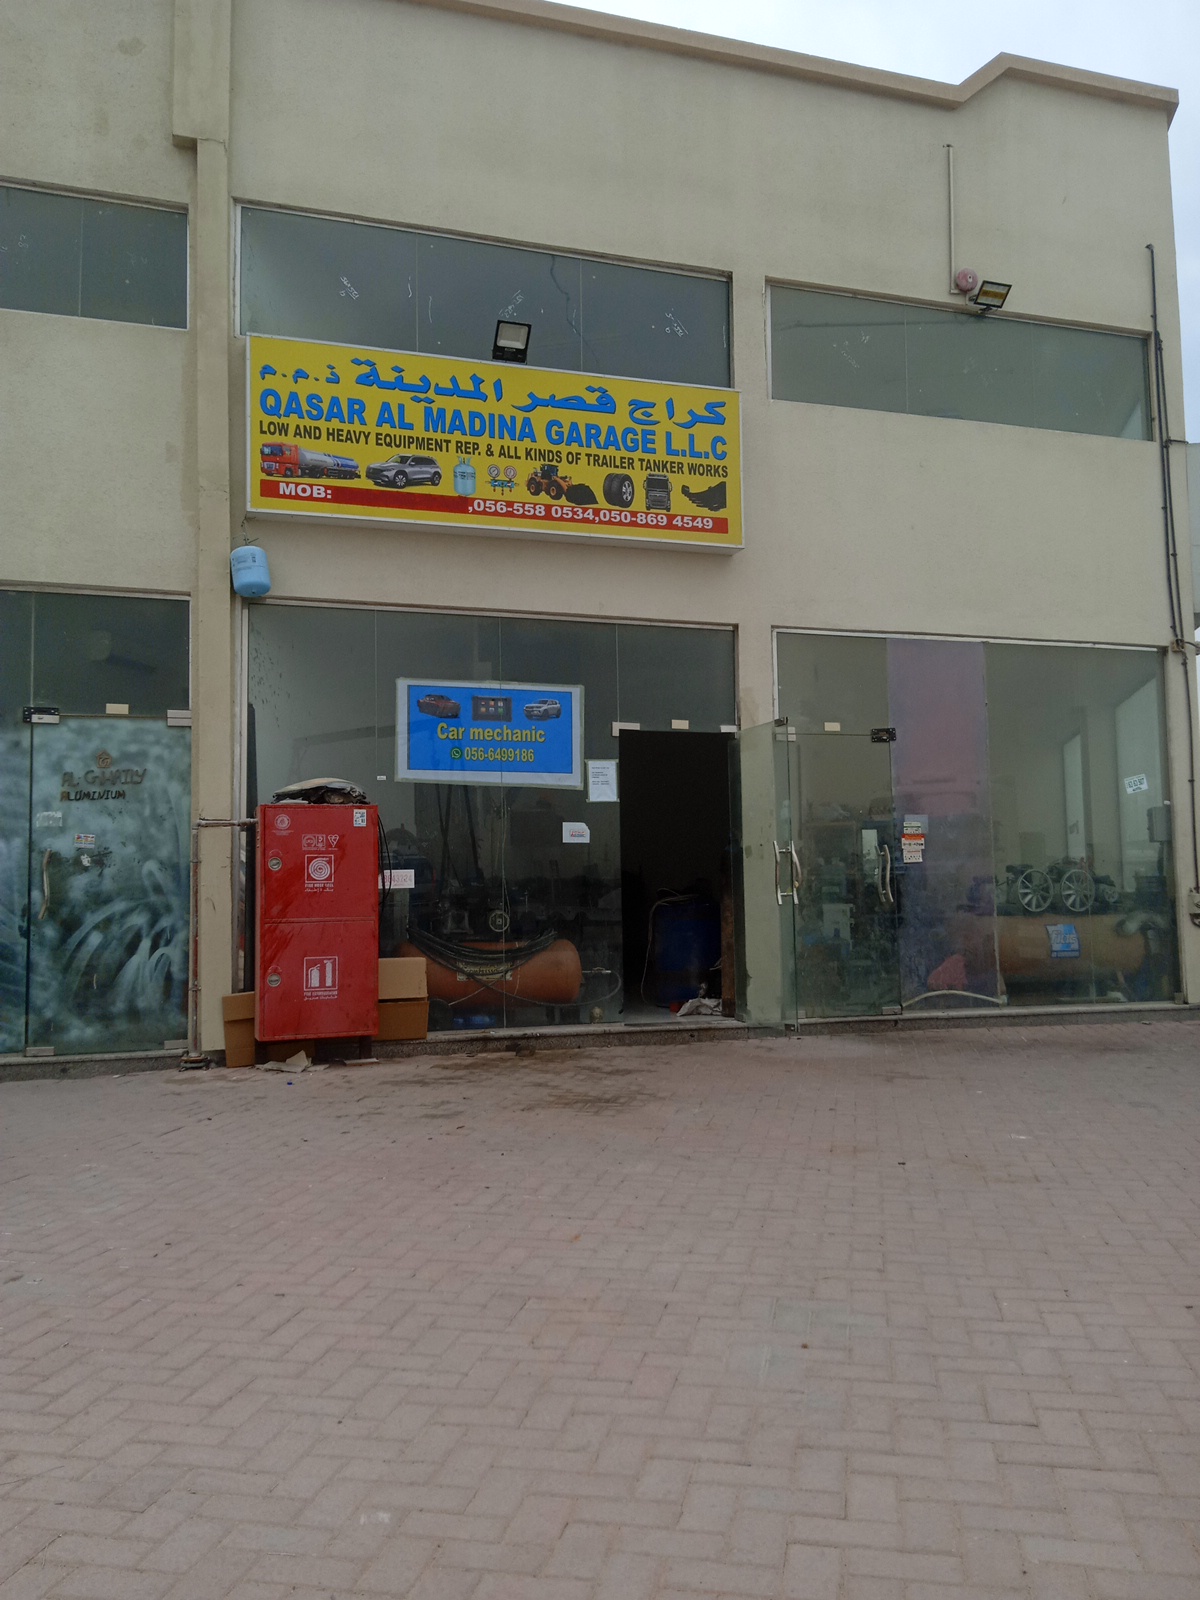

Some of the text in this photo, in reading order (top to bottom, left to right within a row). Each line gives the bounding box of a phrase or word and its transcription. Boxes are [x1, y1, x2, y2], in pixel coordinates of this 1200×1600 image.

[350, 357, 503, 404] المدينة
[511, 385, 617, 414] قصر
[628, 397, 727, 429] كراج
[259, 388, 728, 460] QASAR AL MADINA GARAGE L.L.C
[259, 420, 728, 478] LOW AND HEAVY EQUIPMENT REP. & ALL KINDS OF TRAILER TANKER WORKS
[279, 483, 333, 499] MOB:
[672, 516, 713, 530] 4549
[437, 722, 546, 743] Car mechanic
[464, 747, 535, 763] 056-6499186
[60, 789, 126, 802] ALUMINIUM
